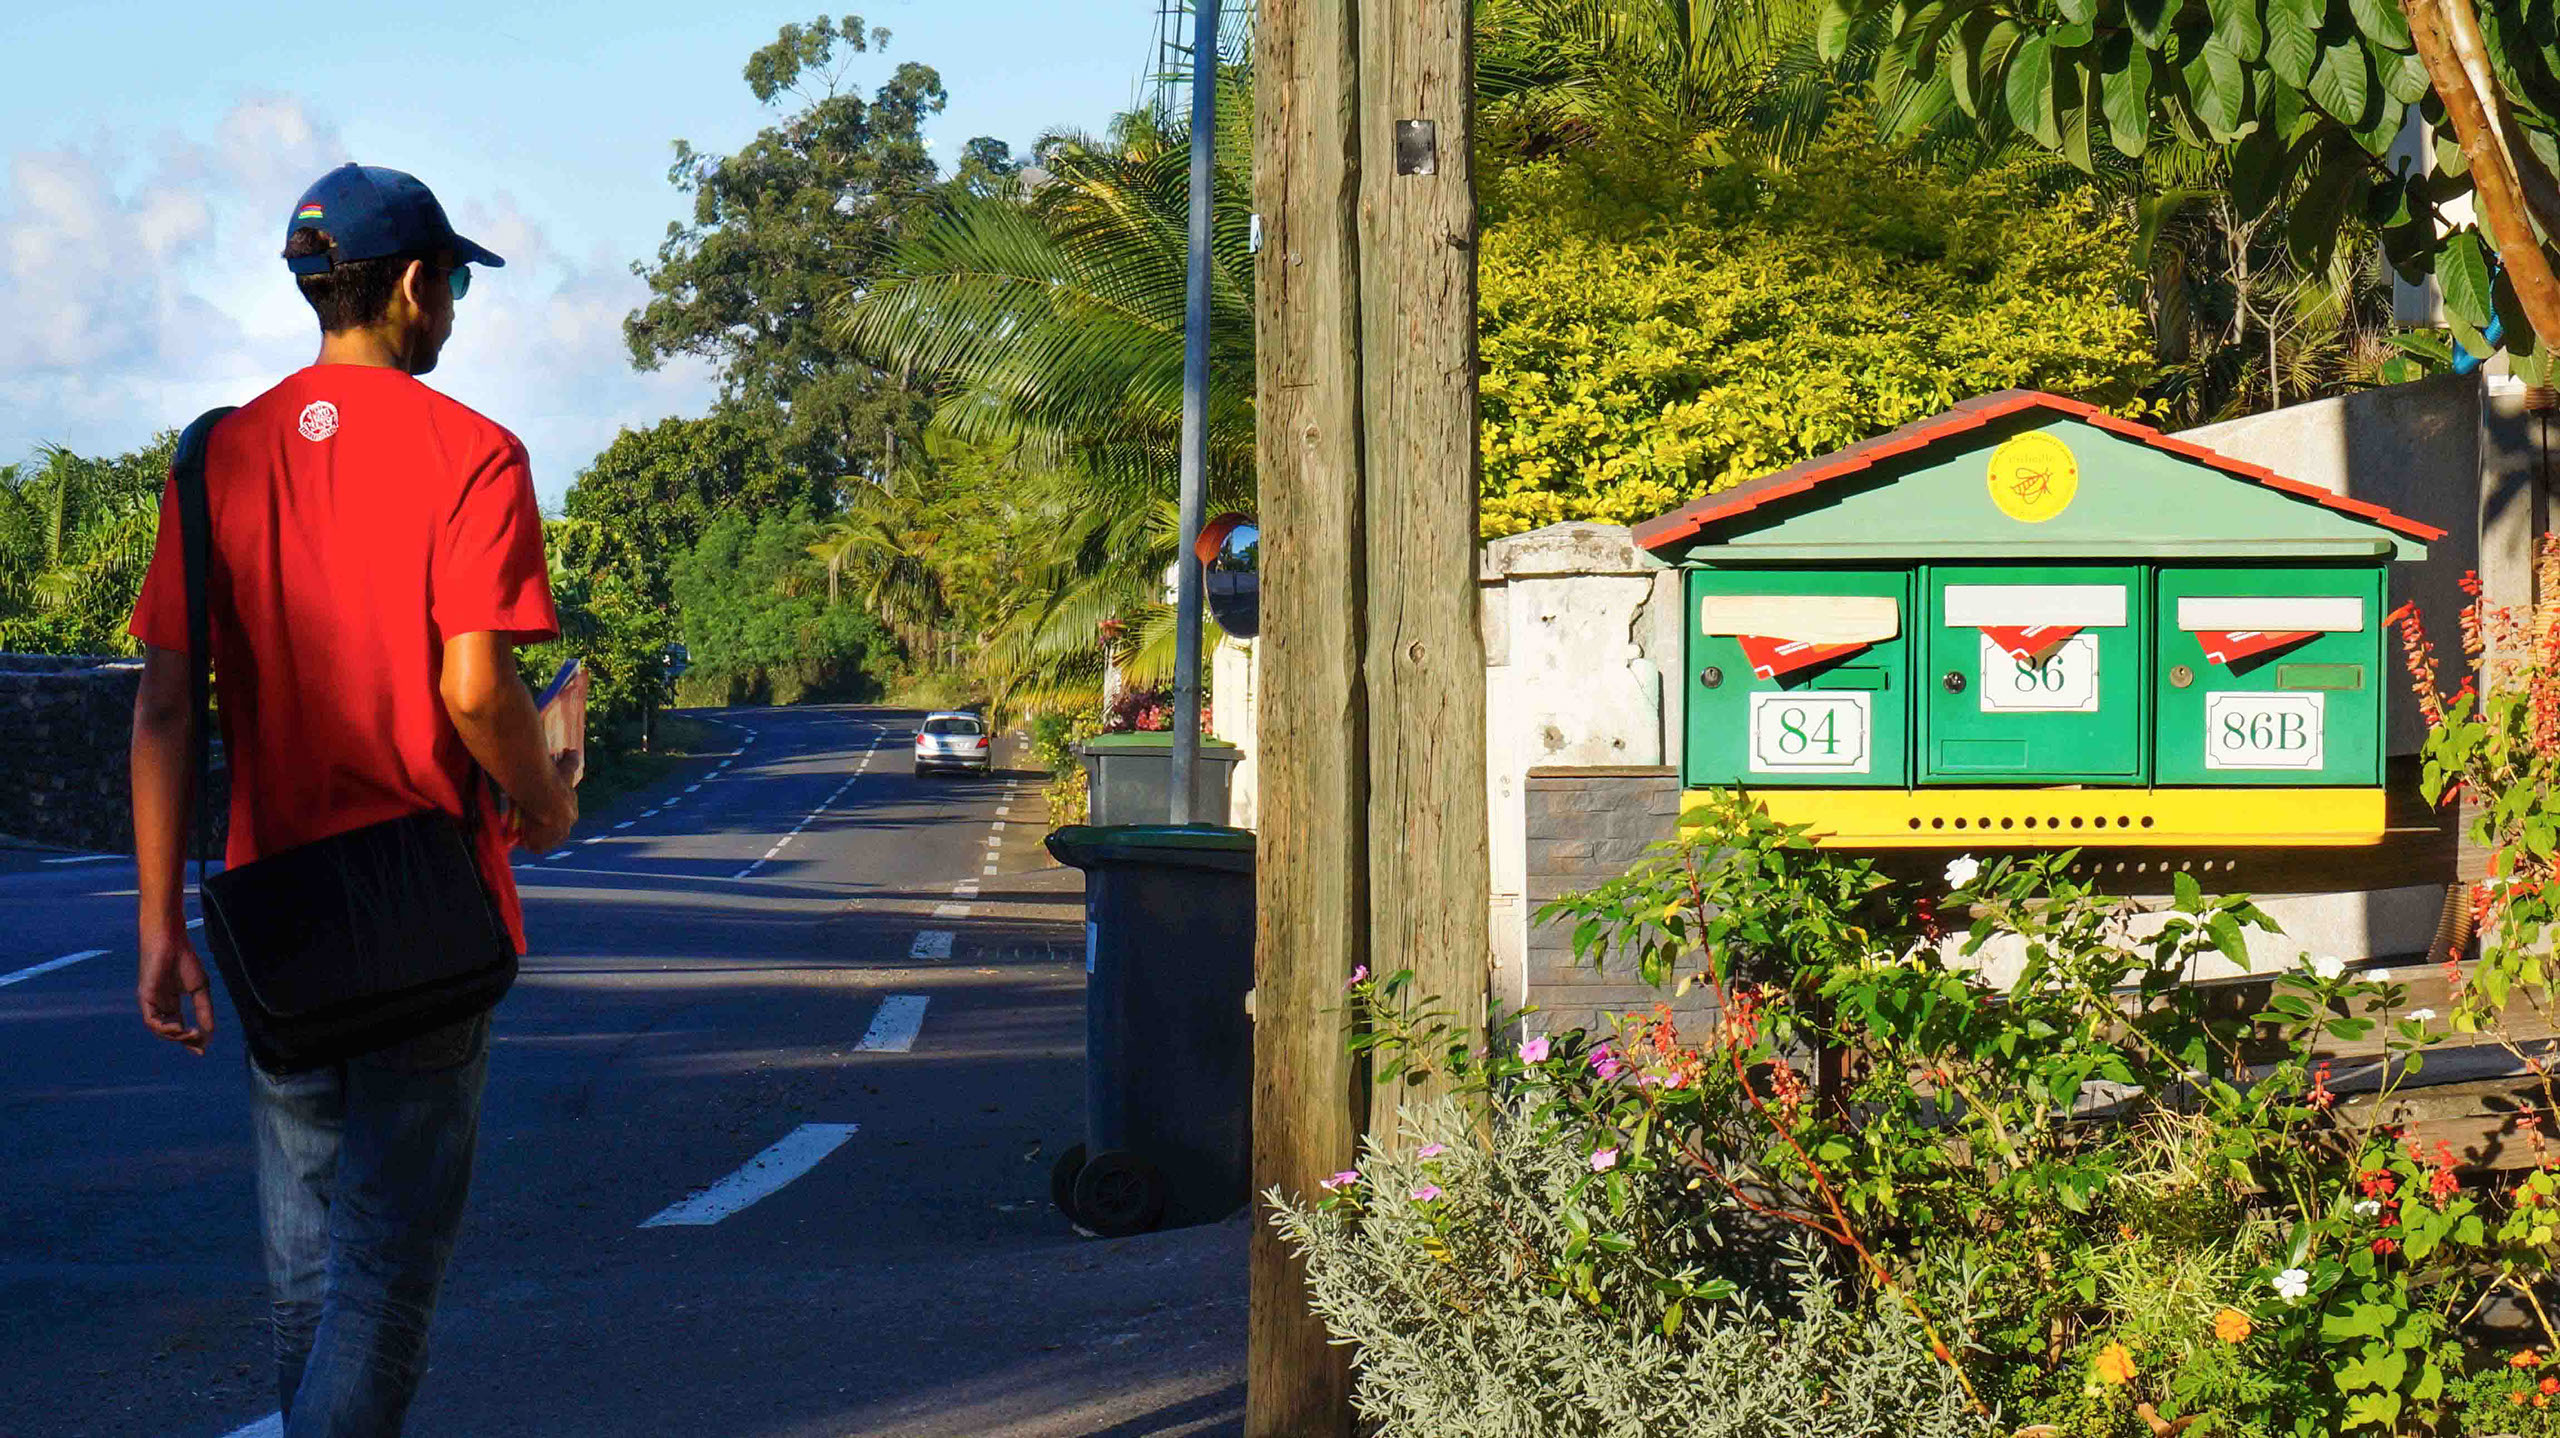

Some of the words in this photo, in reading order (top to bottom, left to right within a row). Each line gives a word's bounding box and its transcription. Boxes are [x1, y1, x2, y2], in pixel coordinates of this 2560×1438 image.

[2015, 654, 2065, 692] 86
[1779, 708, 1841, 755] 84
[2223, 712, 2307, 750] 86B
